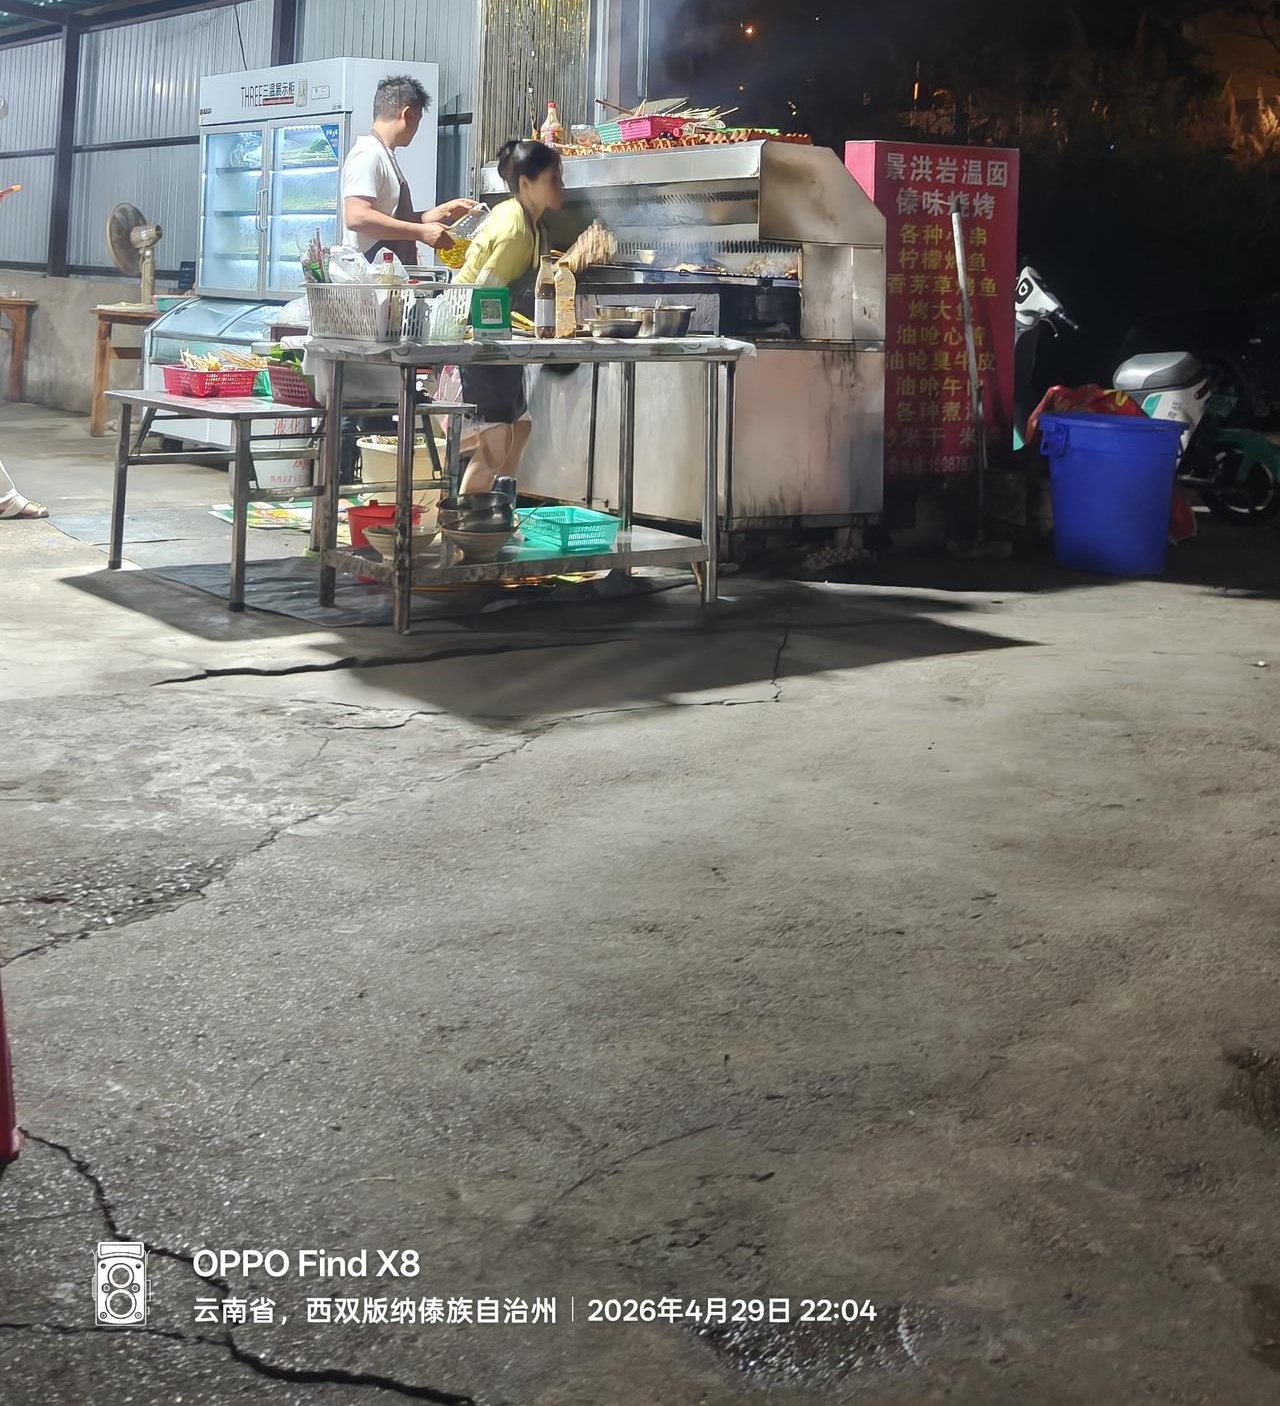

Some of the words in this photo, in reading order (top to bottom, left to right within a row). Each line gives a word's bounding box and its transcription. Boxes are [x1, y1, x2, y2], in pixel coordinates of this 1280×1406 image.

[885, 152, 1009, 188] 景洪岩温囡
[895, 186, 996, 220] 傣味烧烤
[899, 222, 988, 247] 各种串
